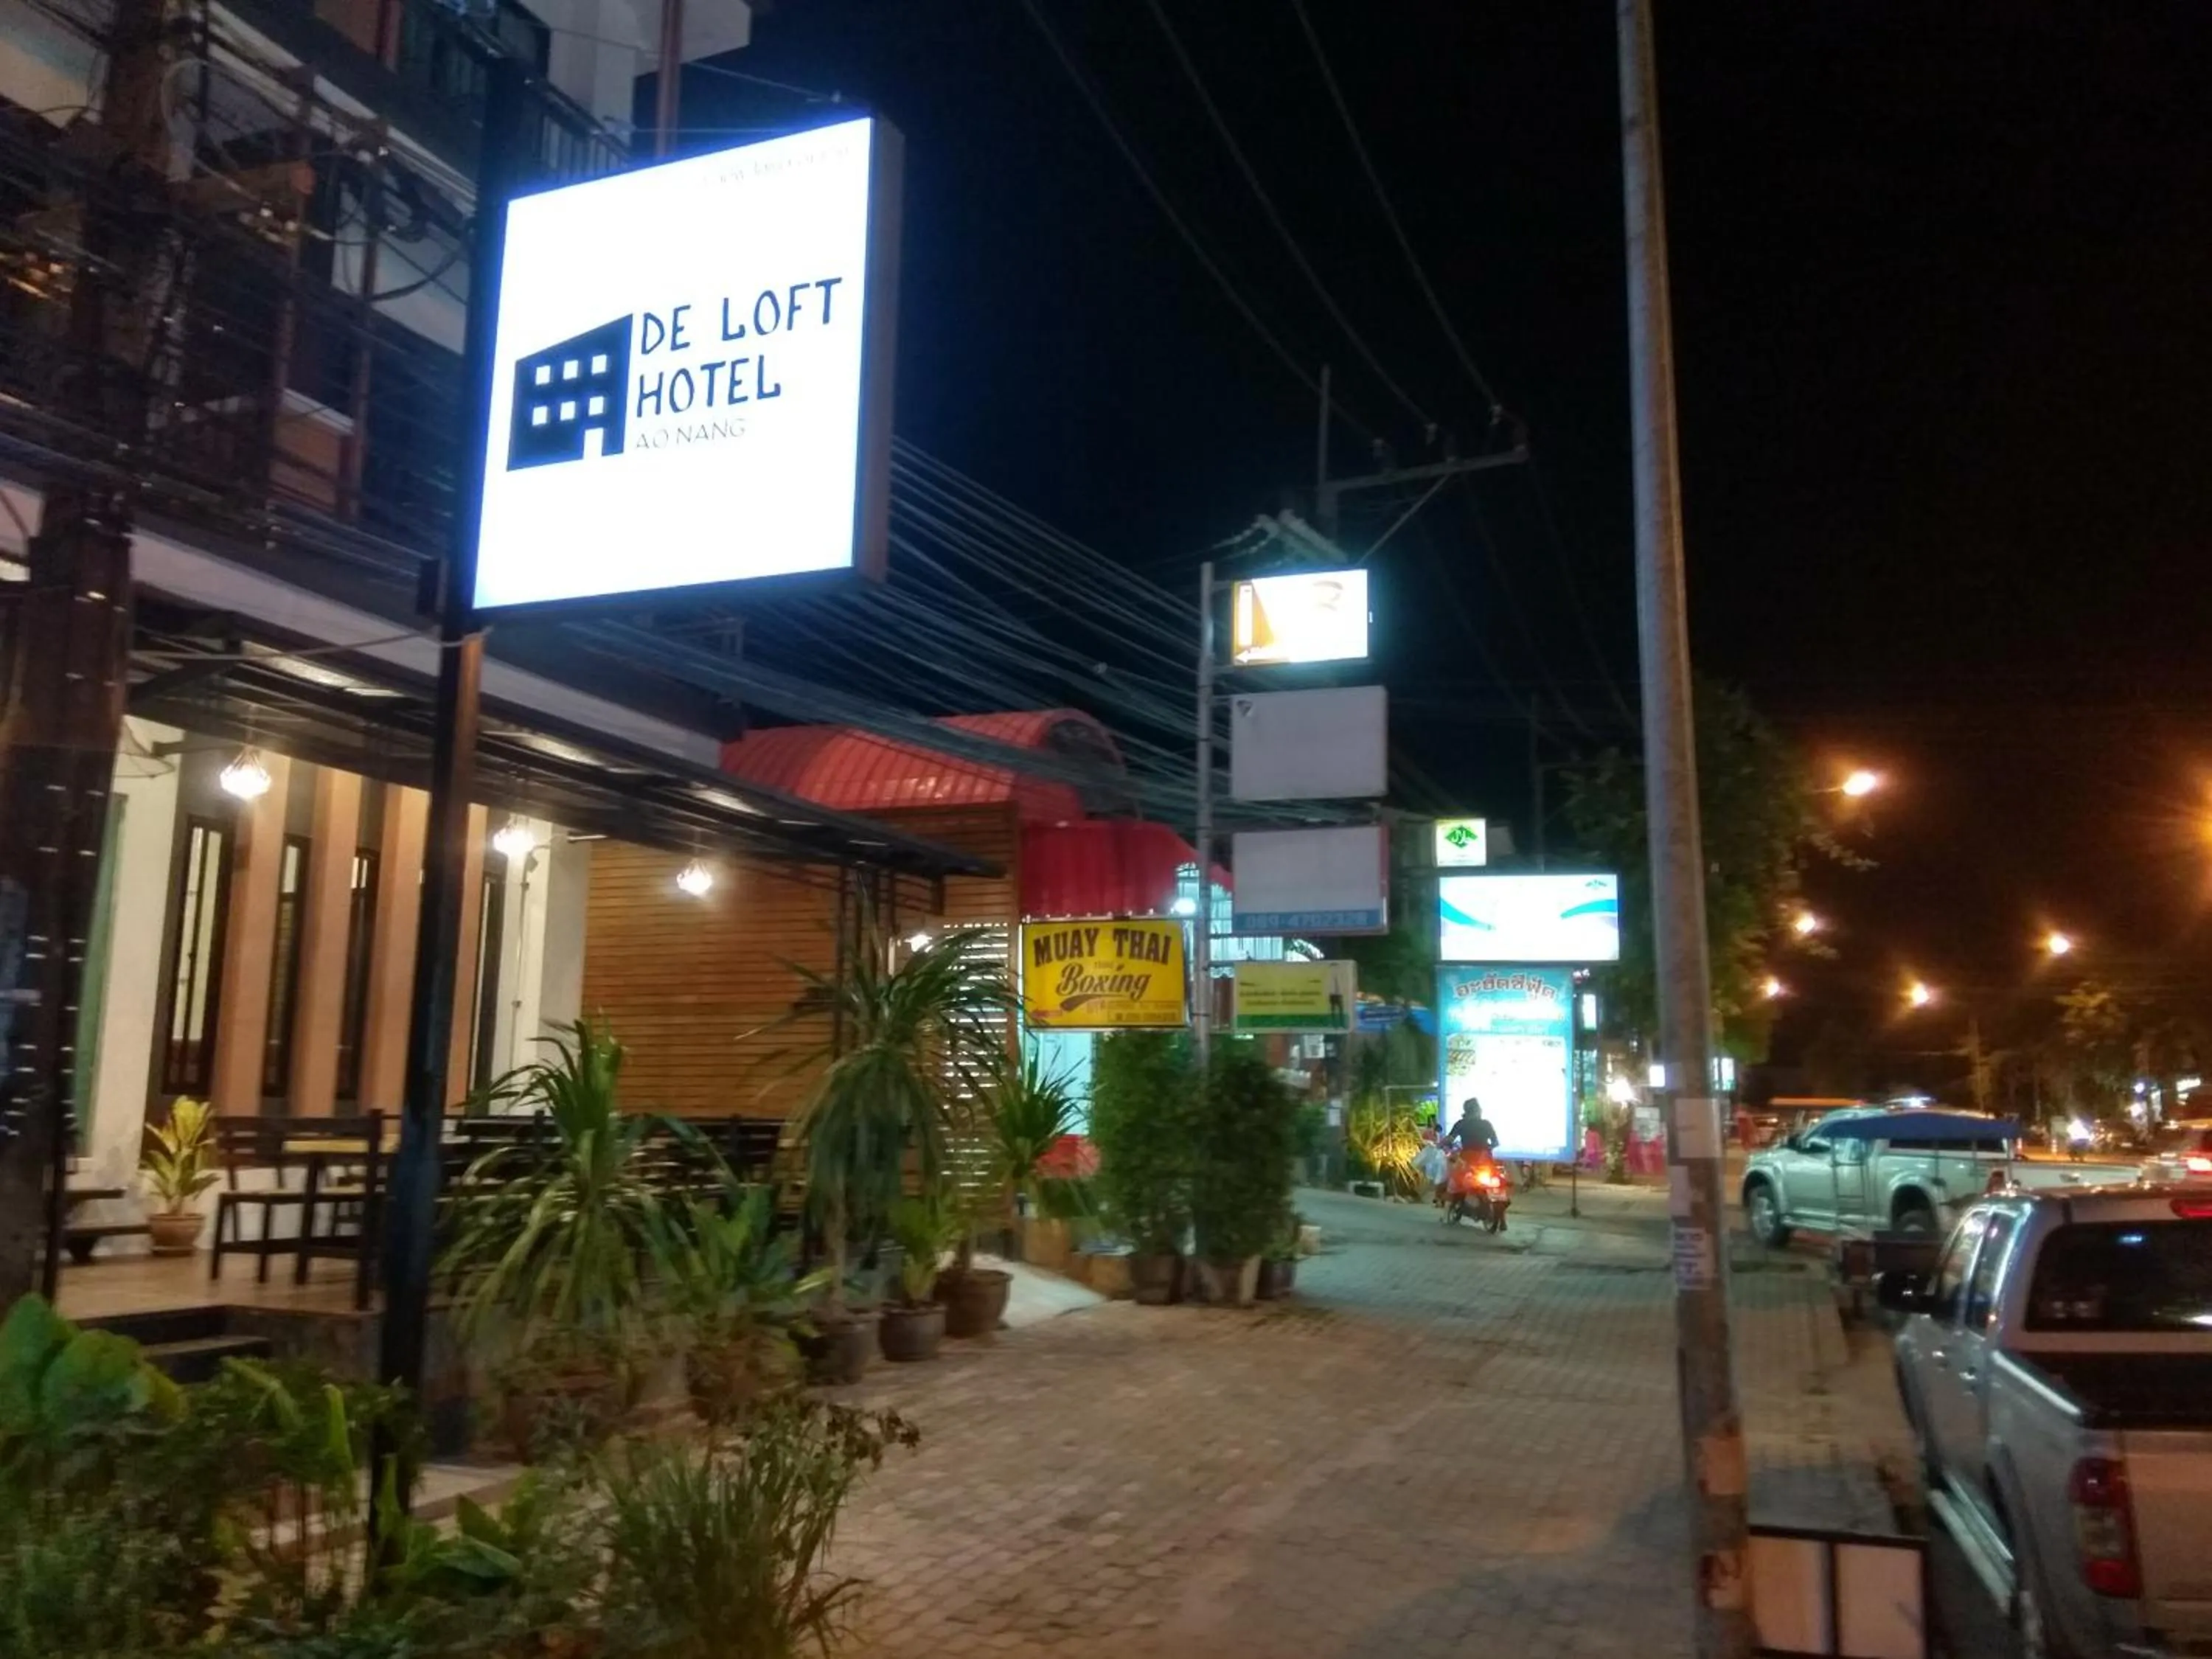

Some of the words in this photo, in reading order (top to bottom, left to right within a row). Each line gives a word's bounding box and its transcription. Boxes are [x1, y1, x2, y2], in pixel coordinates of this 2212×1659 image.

[641, 304, 692, 355] DE
[721, 276, 843, 341] LOFT
[636, 355, 782, 418] HOTEL
[635, 428, 669, 450] AO
[675, 418, 747, 445] NANG
[1033, 928, 1099, 968] MUAY
[1112, 928, 1172, 965] THAI
[1055, 962, 1152, 1001] Boxing
